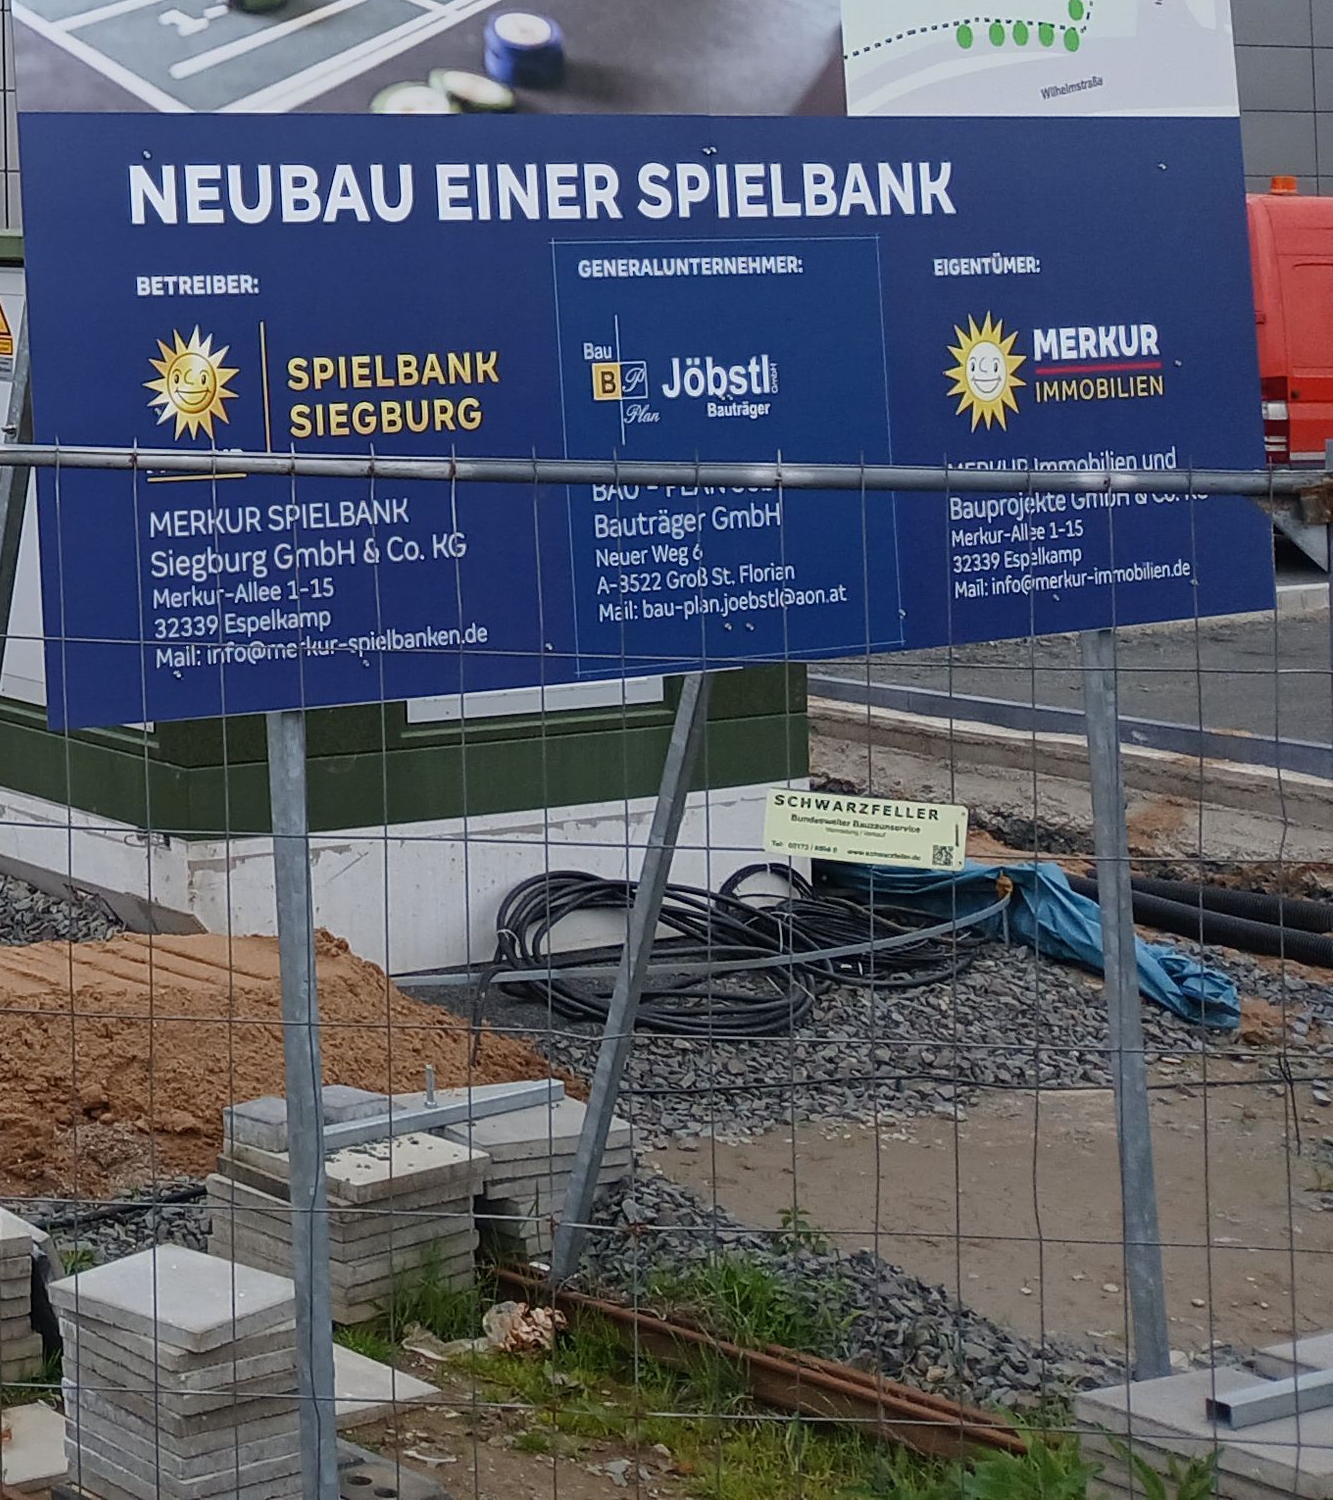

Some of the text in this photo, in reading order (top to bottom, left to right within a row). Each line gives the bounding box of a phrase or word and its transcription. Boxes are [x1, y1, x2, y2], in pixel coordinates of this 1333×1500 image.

[127, 160, 958, 226] NEUBAU EINER SPIELBANK
[578, 255, 804, 278] GENERALUNTERNEHMER:
[933, 252, 1041, 276] EIGENTÜMER:
[136, 274, 260, 296] BETREIBER:
[584, 342, 612, 359] Bau
[1033, 323, 1161, 361] MERKUR
[286, 350, 500, 392] SPIELBANK
[662, 354, 770, 399] Jöbstl
[1035, 375, 1164, 403] IMMOBILIEN
[288, 396, 484, 439] SIEGBURG
[623, 403, 661, 424] Plan
[707, 402, 771, 420] Bauträger
[1033, 450, 1138, 471] Immobilien
[1142, 446, 1178, 470] und
[148, 497, 410, 539] MERKUR SPIELBANK
[594, 502, 782, 540] Bauträger GmbH
[949, 491, 1067, 524] Bauprojekte
[951, 519, 1084, 548] Merkur-Allee 1-15
[150, 532, 468, 583] Siegburg GmbH & Co. KG
[595, 543, 704, 568] Neuer Weg 6
[952, 547, 1083, 574] 32339 Espelkamp
[666, 566, 709, 590] Groß
[711, 567, 736, 586] St.
[739, 563, 796, 584] Florian
[955, 561, 1192, 599] Mail: info@merkur-immobilien.de
[152, 577, 335, 610] Merkur-Allee 1-15
[599, 584, 848, 623] Mail: bau-plan.joebstl@aon.at
[154, 609, 332, 639] 32339 Espelkamp
[156, 622, 489, 669] Mail: info@merkur-spielbanken.de
[773, 794, 940, 821] SCHWARZFELLER
